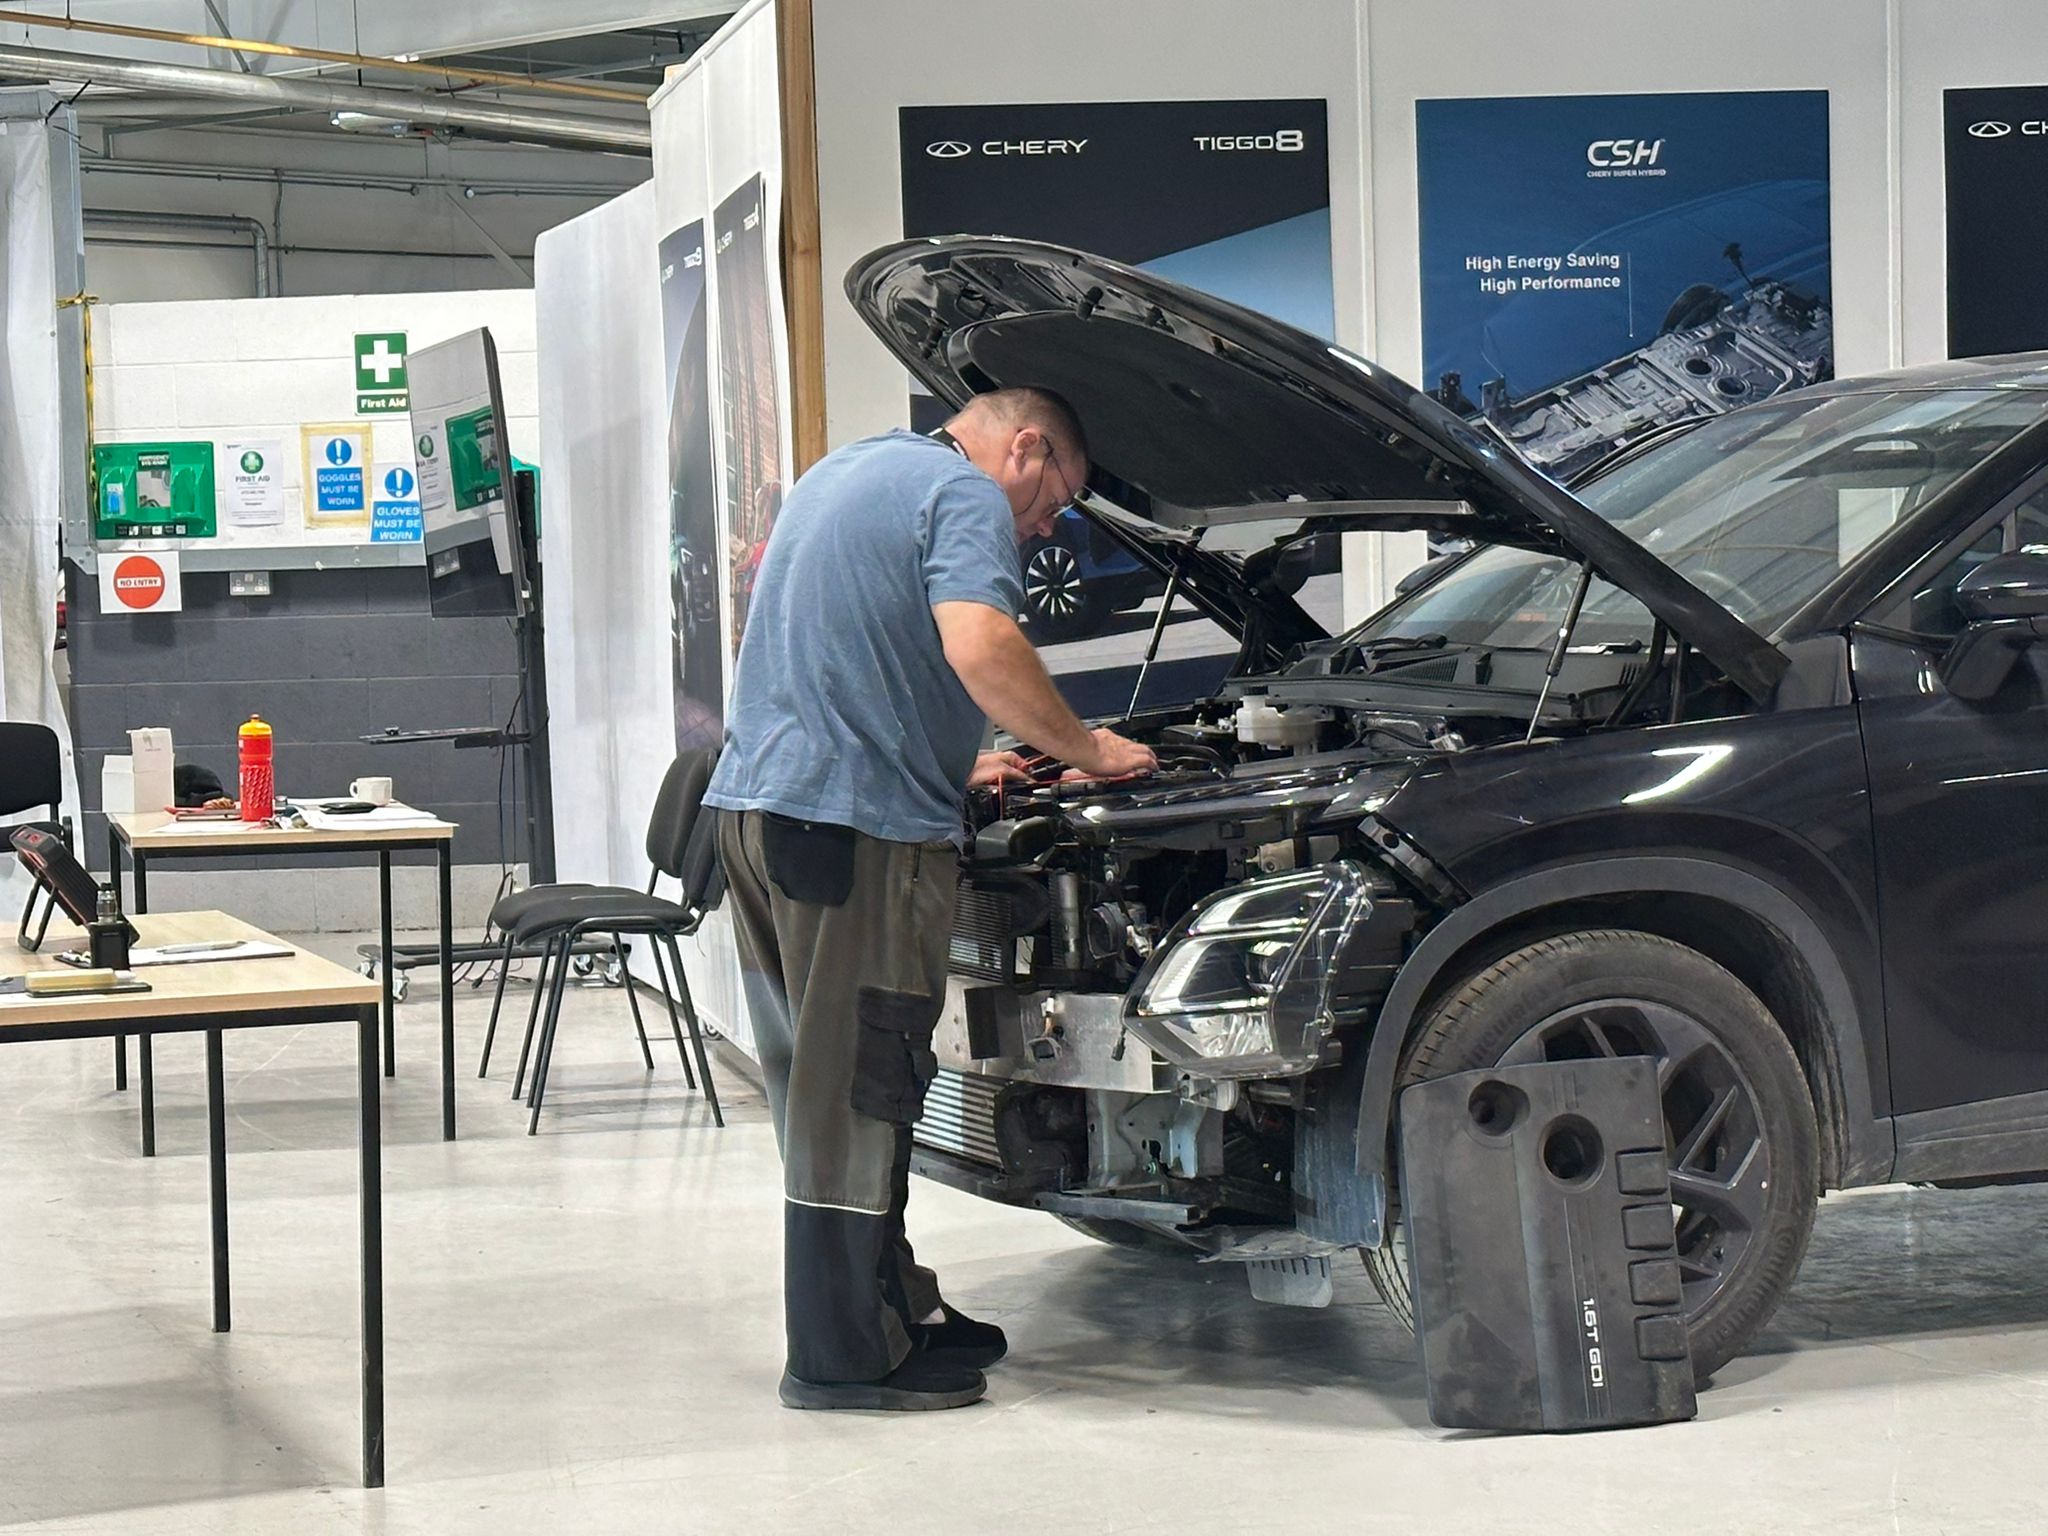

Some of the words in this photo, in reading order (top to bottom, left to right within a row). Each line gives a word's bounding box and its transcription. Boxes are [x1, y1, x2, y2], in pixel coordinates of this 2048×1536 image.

[982, 139, 1089, 156] CHERY
[1587, 139, 1661, 167] CSH
[1586, 170, 1611, 178] CHERY
[1465, 256, 1502, 273] High
[1507, 255, 1562, 271] Energy
[1566, 252, 1620, 269] Saving
[1480, 278, 1516, 294] High
[1521, 276, 1621, 290] Performance
[361, 398, 386, 409] First
[388, 397, 407, 408] Aid
[318, 473, 361, 482] GOGGLES
[321, 485, 345, 494] MUST
[347, 485, 359, 493] BE
[327, 497, 355, 505] WORN
[376, 506, 420, 516] GLOVES
[374, 519, 403, 528] MUST
[406, 519, 421, 528] BE
[379, 532, 413, 540] WORN
[1583, 1298, 1599, 1343] 1.6T
[1588, 1347, 1604, 1388] GDI
